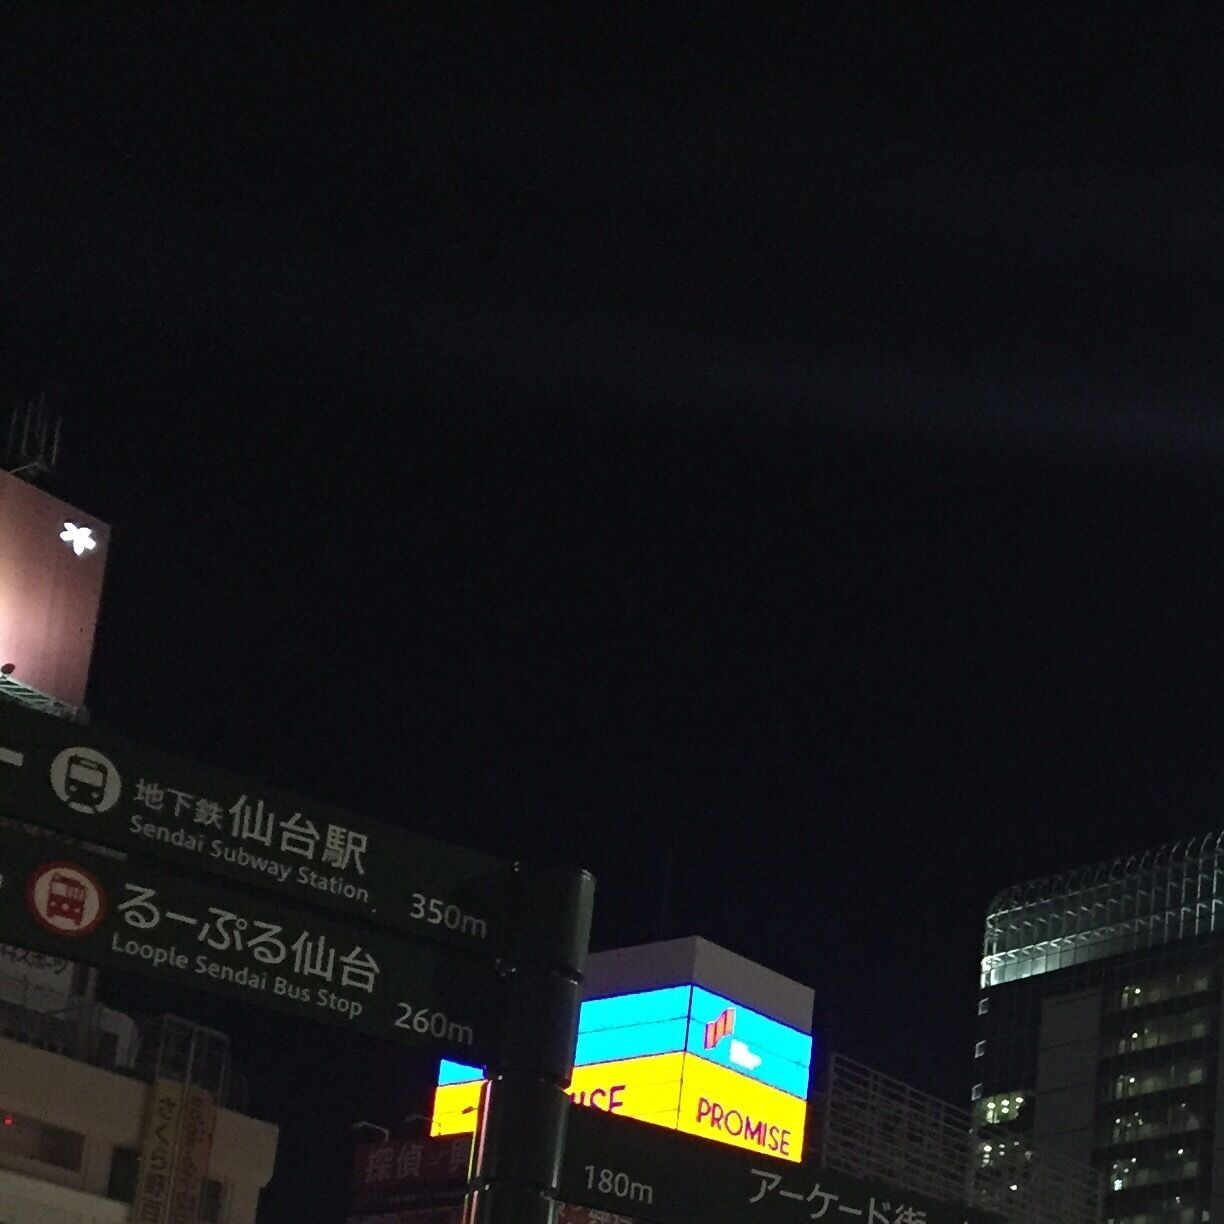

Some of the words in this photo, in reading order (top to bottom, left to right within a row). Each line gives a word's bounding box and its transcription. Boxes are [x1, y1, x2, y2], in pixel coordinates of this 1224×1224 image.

[129, 814, 205, 851] Sendai
[210, 839, 292, 882] Subway
[297, 866, 369, 903] Station
[117, 882, 381, 993] るーぷる仙台
[409, 893, 487, 940] 350m
[112, 931, 190, 969] Loople
[194, 955, 268, 990] Sendai
[273, 976, 311, 1003] Bus
[316, 988, 363, 1020] Stop
[394, 1002, 474, 1046] 260m
[696, 1097, 791, 1157] PROMISE
[584, 1165, 653, 1204] 180m
